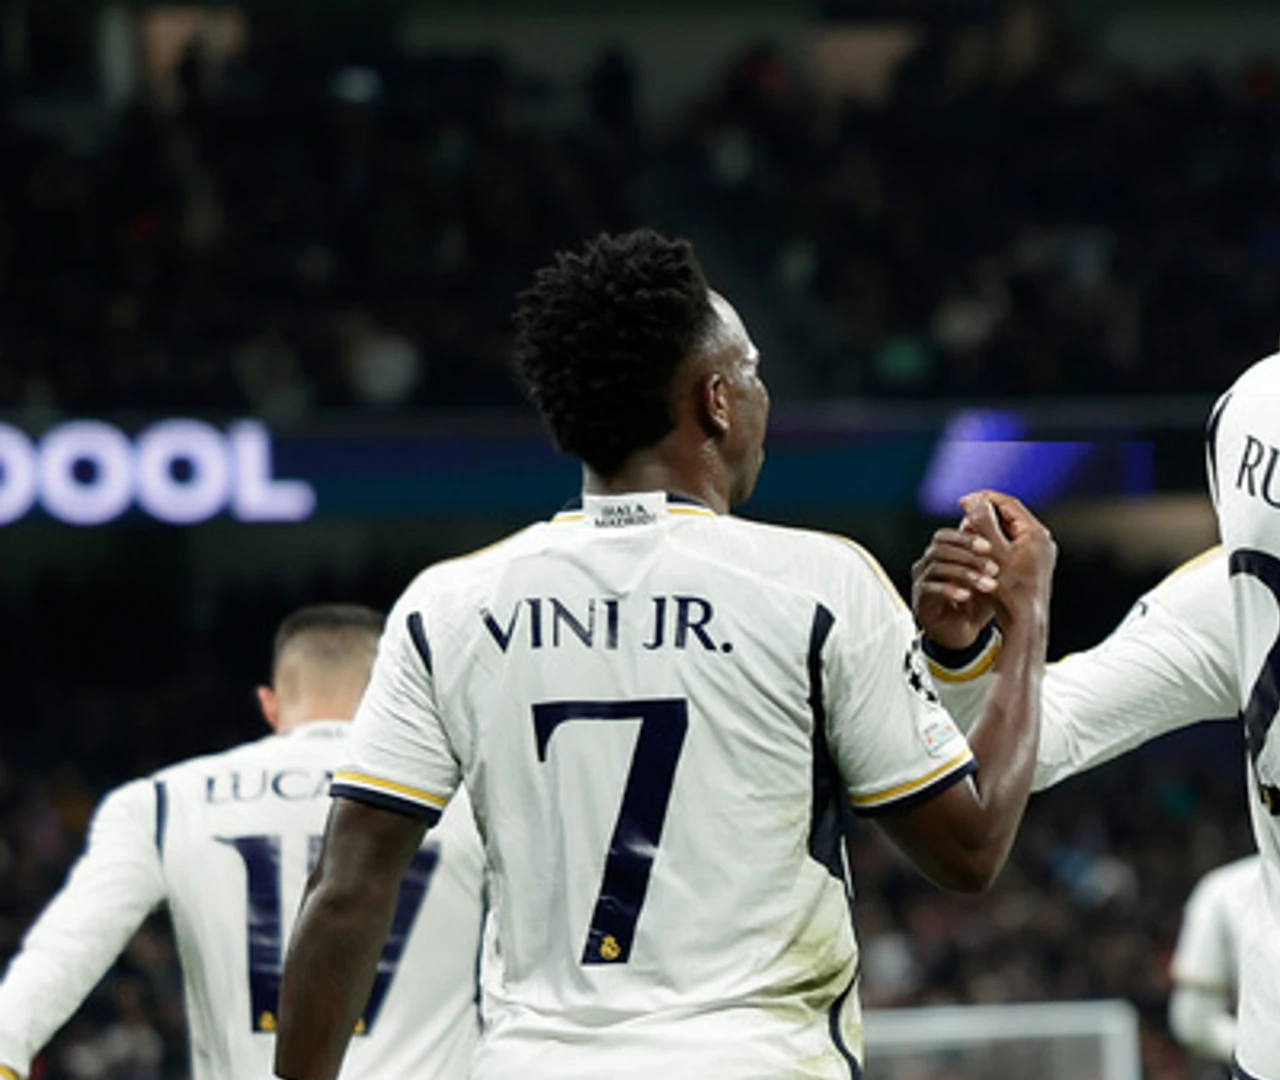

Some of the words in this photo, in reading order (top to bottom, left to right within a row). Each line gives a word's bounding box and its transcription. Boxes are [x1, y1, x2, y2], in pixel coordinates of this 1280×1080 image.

[479, 596, 620, 654] VINI
[642, 595, 734, 654] JR.
[531, 697, 689, 965] 7
